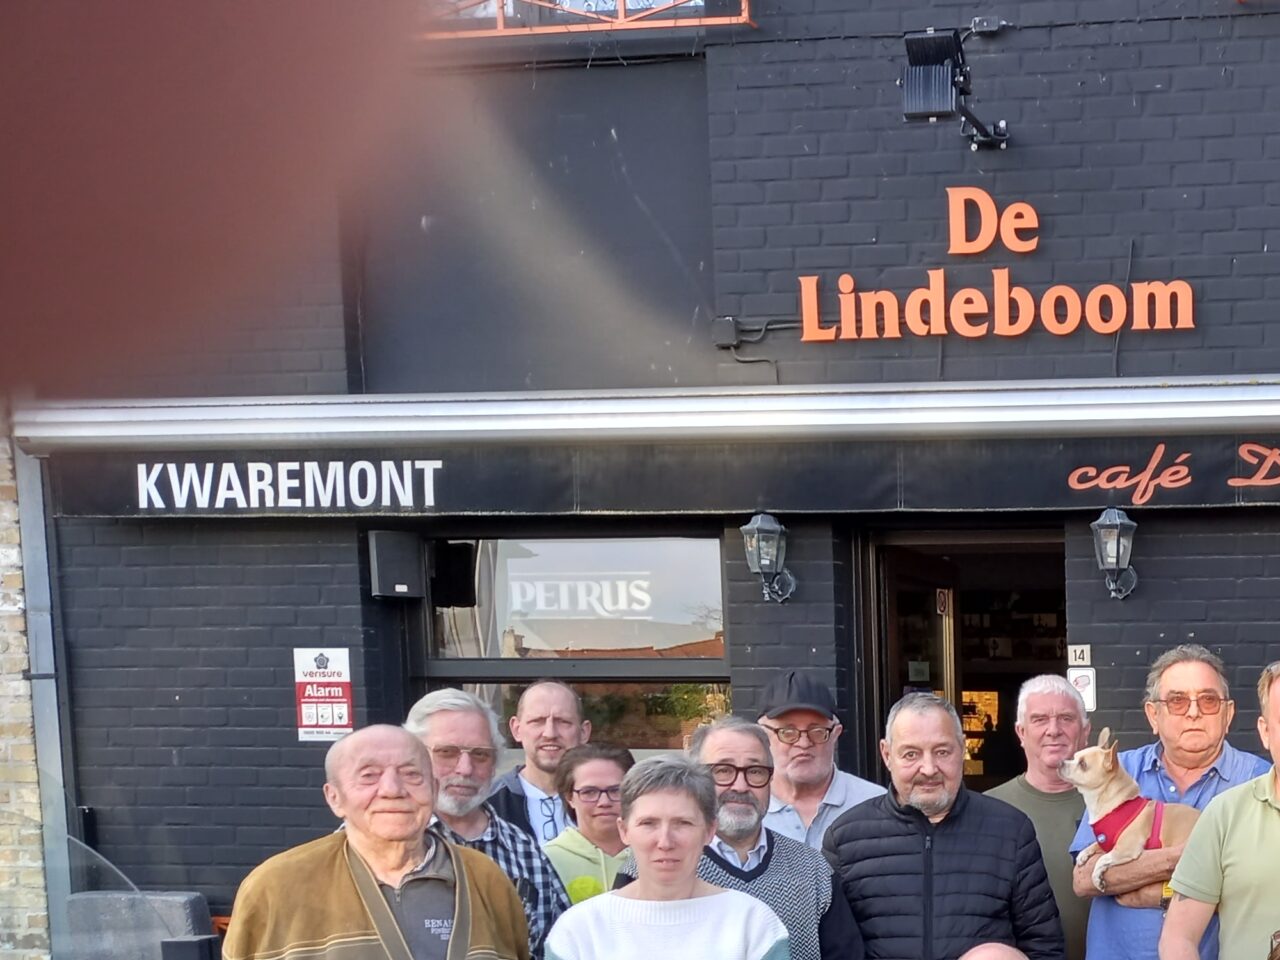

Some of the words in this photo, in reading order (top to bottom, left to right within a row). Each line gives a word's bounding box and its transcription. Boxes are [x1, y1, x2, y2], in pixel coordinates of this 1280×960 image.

[947, 186, 1039, 255] De
[798, 267, 1195, 342] Lindeboom
[136, 459, 443, 509] KWAREMONT
[1067, 443, 1192, 505] café
[510, 579, 652, 617] PETRUS
[1073, 649, 1085, 661] 14
[304, 684, 342, 696] Alarm
